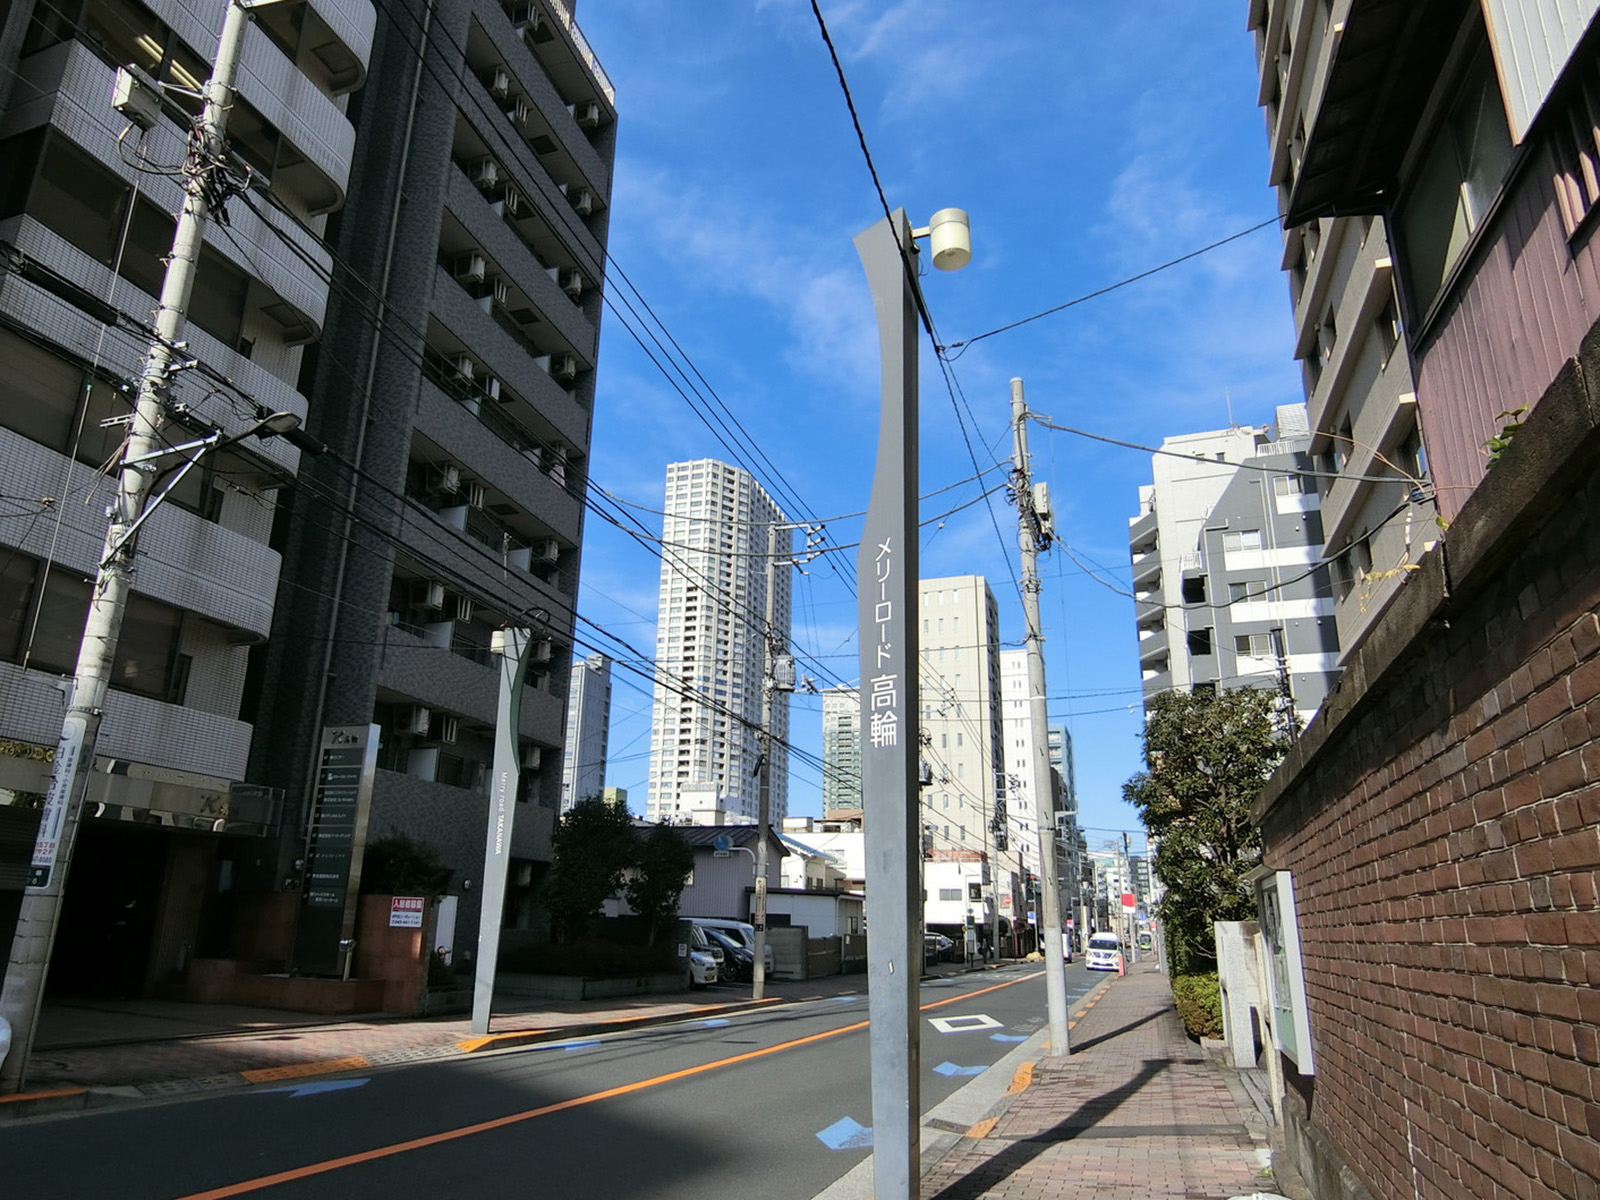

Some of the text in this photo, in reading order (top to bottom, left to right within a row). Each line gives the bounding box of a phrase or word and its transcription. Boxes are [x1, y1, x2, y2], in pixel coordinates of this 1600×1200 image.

[870, 537, 898, 748] メリーロード高輪
[499, 771, 508, 792] Merry
[494, 814, 505, 856] TAKANAWA
[393, 899, 422, 909] 入居者募集
